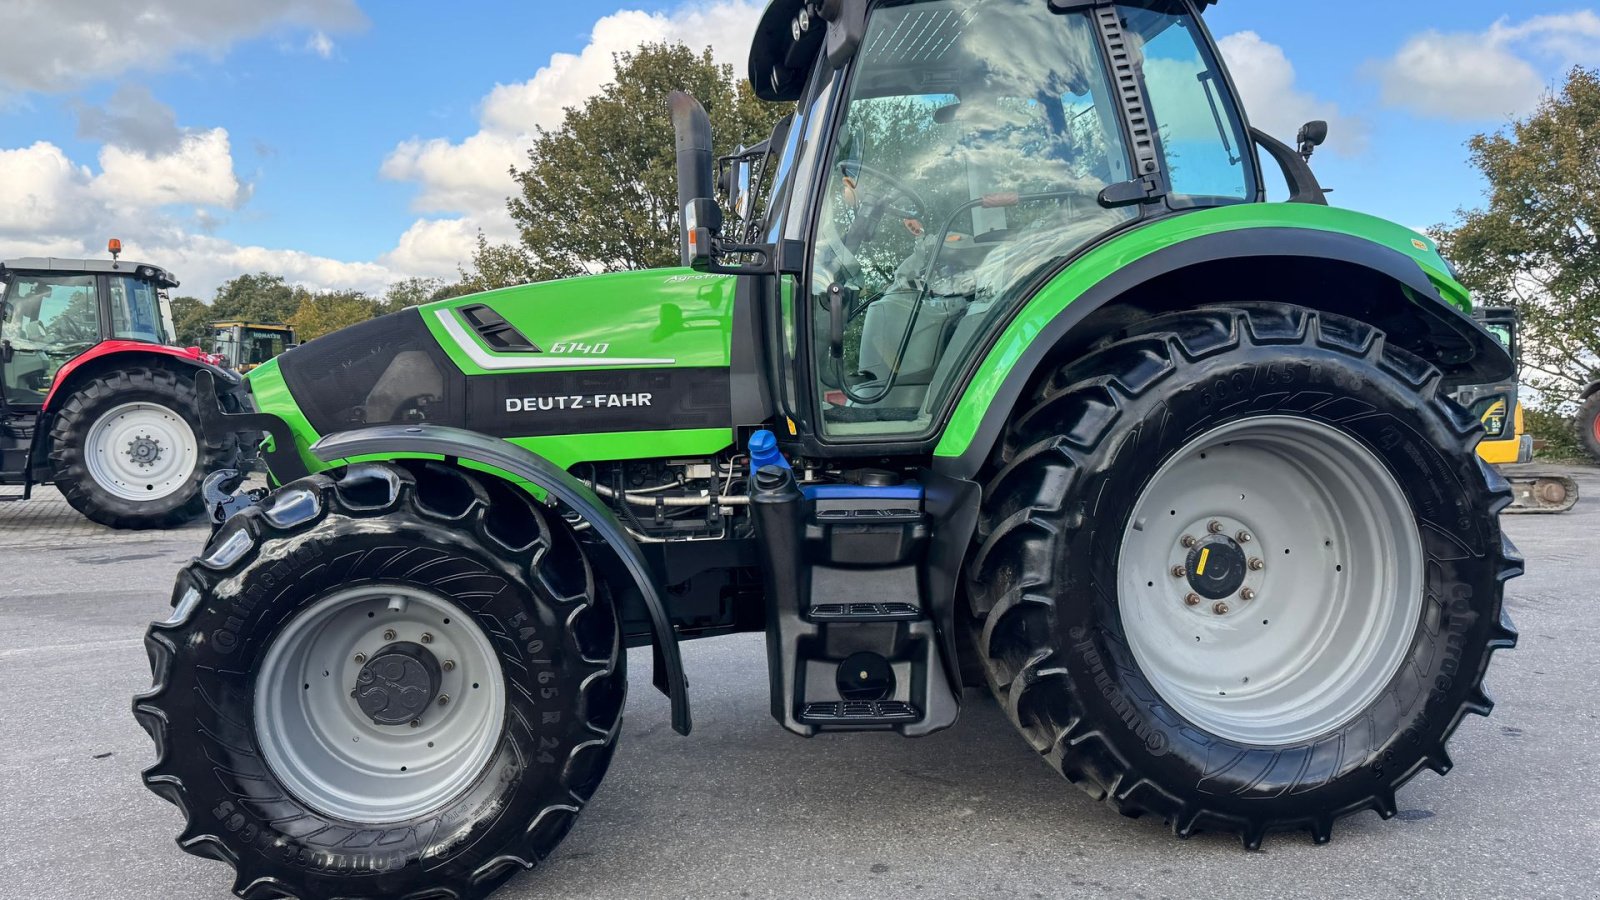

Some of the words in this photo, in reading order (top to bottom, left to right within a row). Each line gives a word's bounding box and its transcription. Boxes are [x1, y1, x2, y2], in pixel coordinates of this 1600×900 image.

[253, 331, 281, 340] KOMATSU
[550, 342, 610, 354] 6140
[505, 392, 652, 412] DEUTZ-FAHR
[507, 611, 560, 700] 540/65
[541, 711, 561, 725] R
[537, 735, 560, 764] 24
